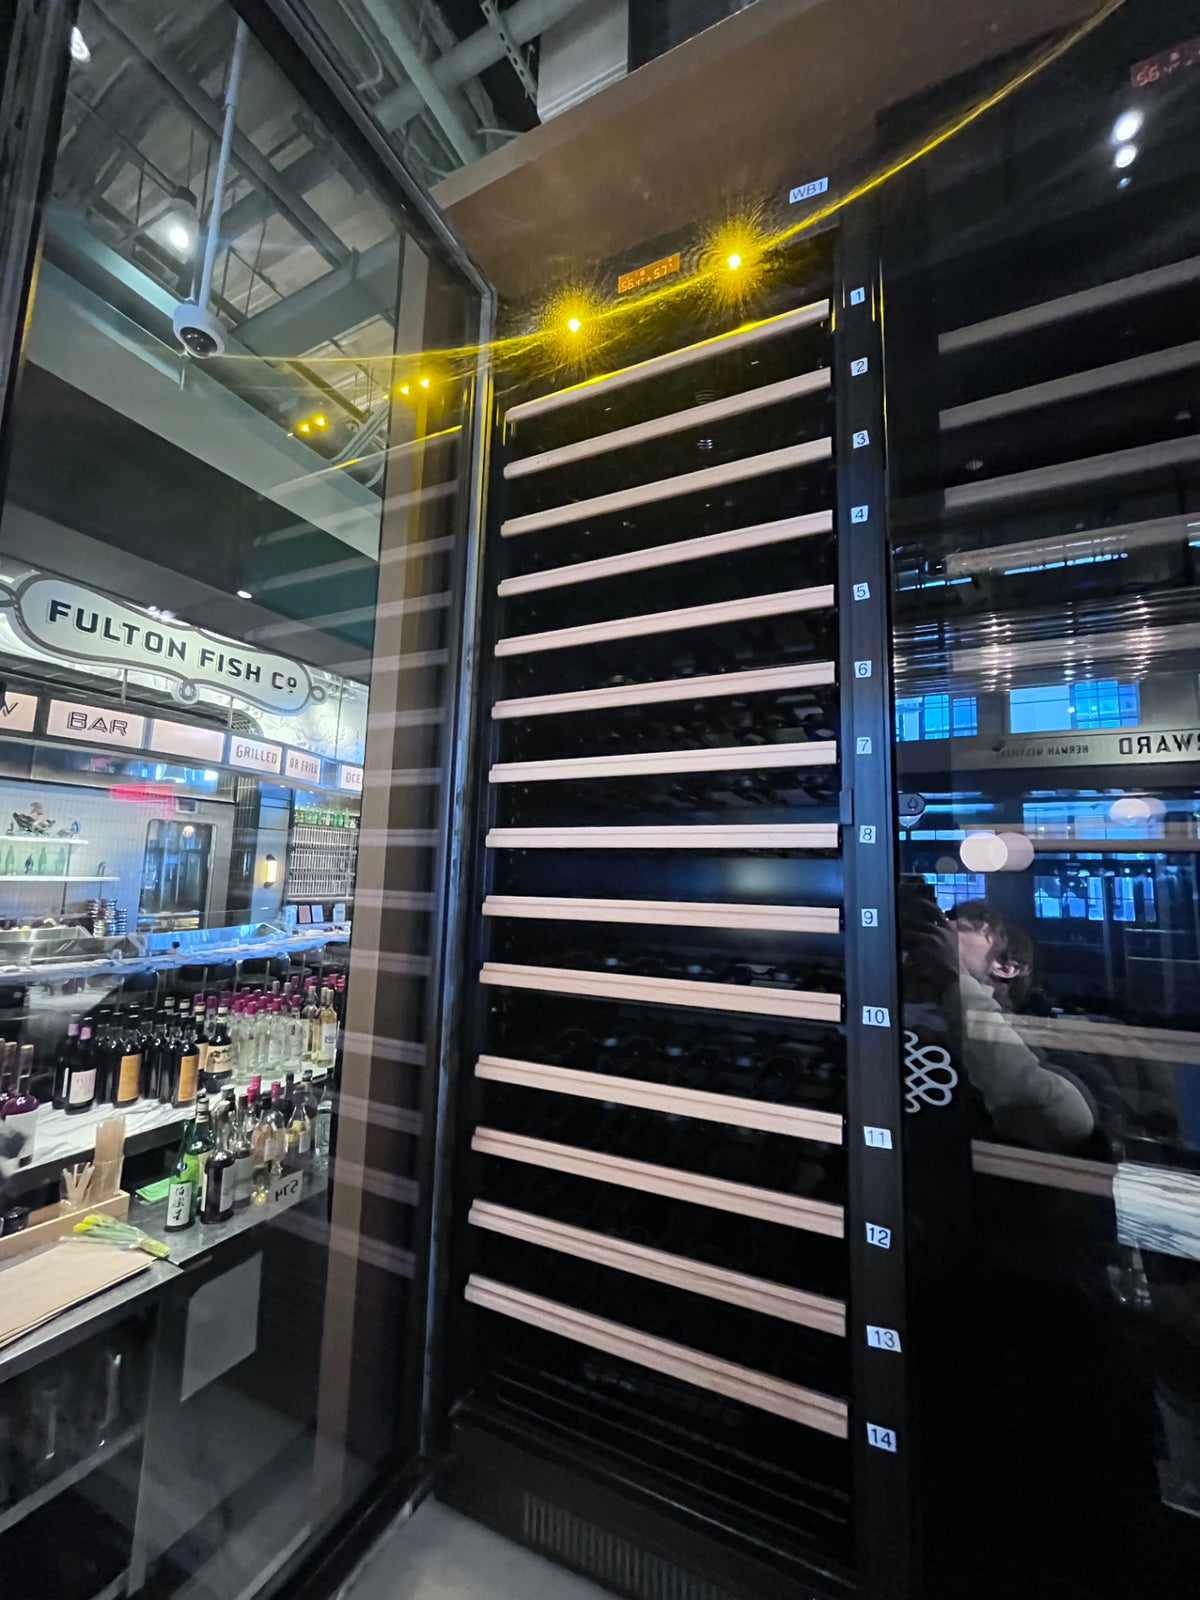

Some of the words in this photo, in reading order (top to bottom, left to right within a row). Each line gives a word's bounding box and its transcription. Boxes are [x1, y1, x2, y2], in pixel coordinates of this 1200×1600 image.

[792, 180, 823, 200] WB1
[856, 360, 865, 373] 2
[857, 432, 866, 445] 3
[855, 508, 864, 520] 4
[857, 586, 866, 599] 5
[49, 599, 187, 661] FULTON
[200, 648, 261, 684] FISH
[858, 663, 868, 676] 6
[67, 711, 129, 736] BAR
[859, 739, 870, 751] 7
[236, 744, 278, 765] GRILLED
[862, 827, 872, 841] 8
[864, 910, 873, 925] 9
[866, 1009, 884, 1025] 10
[869, 1129, 885, 1146] 11
[869, 1226, 888, 1247] 12
[874, 1329, 895, 1349] 13
[872, 1427, 892, 1449] 14
